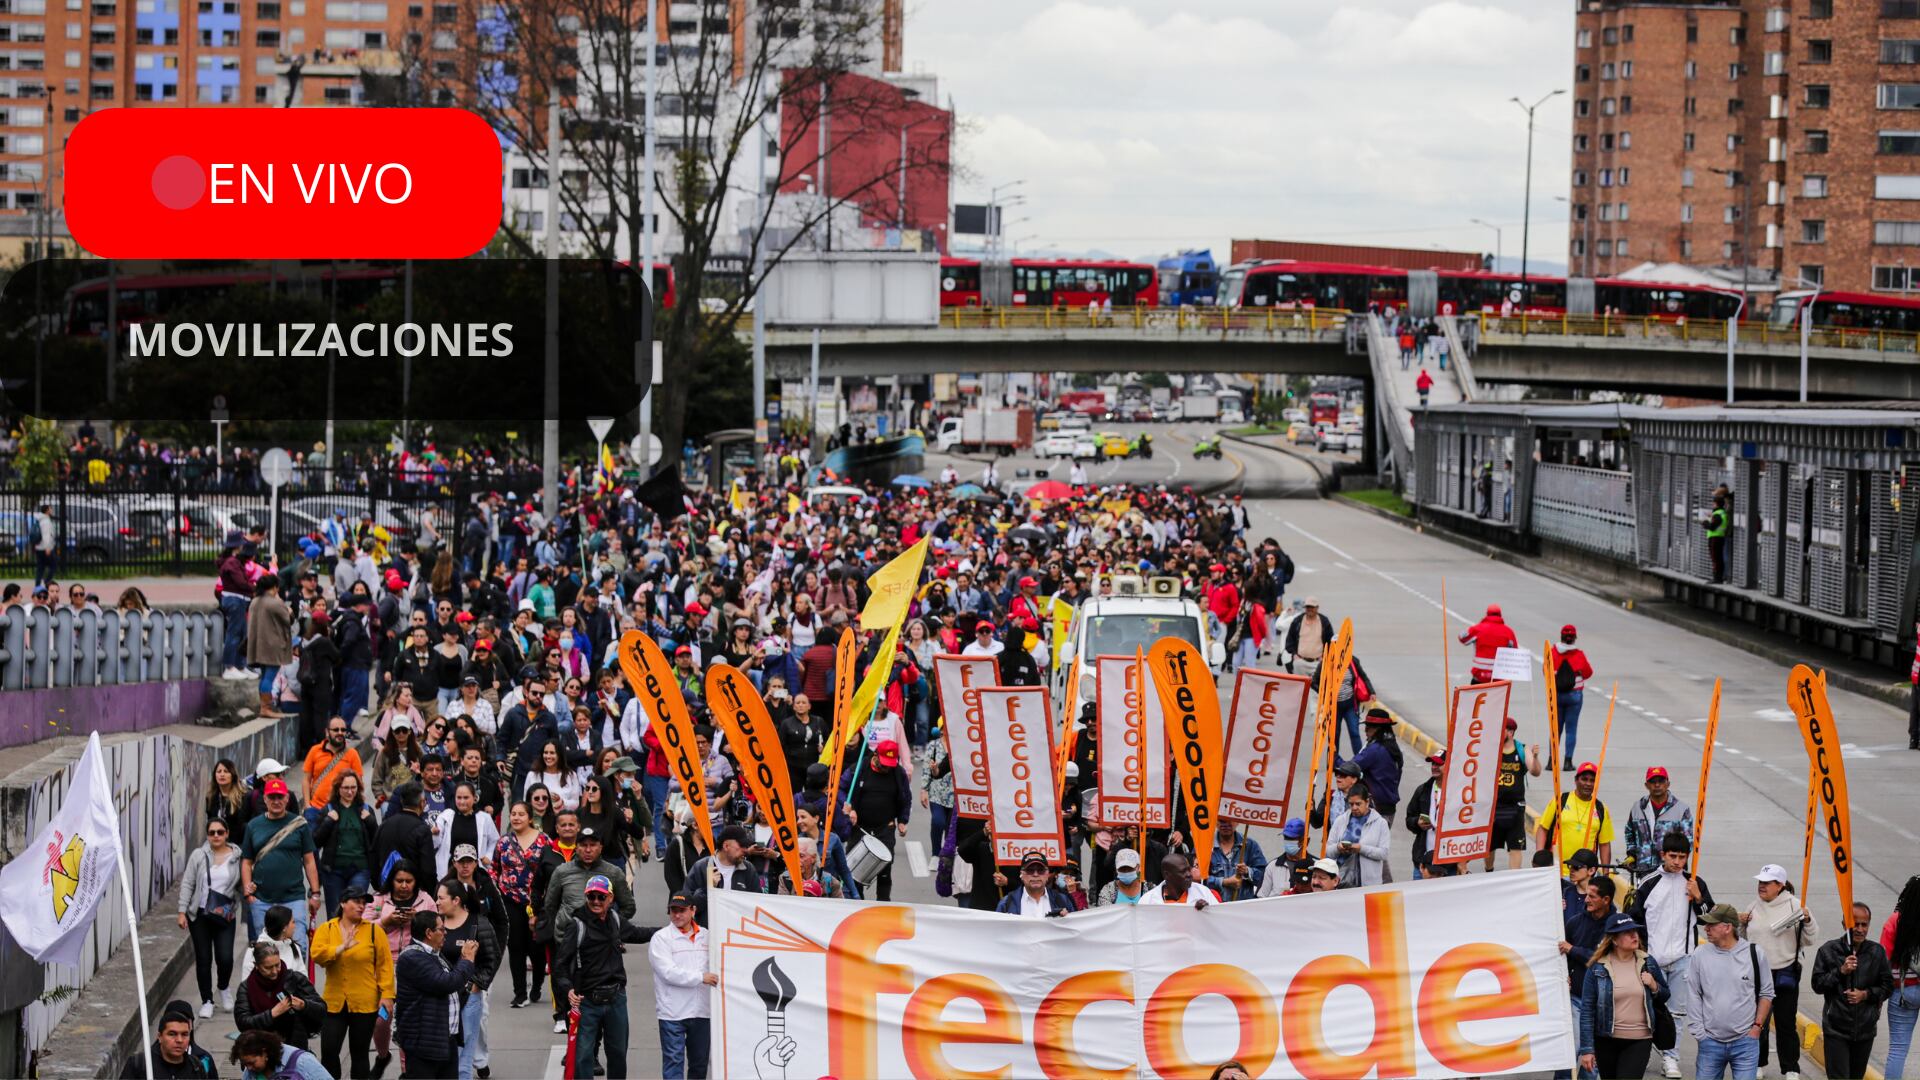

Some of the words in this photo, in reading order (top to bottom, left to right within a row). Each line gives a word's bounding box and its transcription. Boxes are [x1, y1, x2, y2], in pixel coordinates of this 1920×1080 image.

[635, 640, 702, 806] fecode
[725, 674, 794, 852] fecode
[1007, 695, 1034, 828] fecode
[1176, 651, 1209, 830] fecode
[1245, 681, 1280, 794] fecode
[1458, 692, 1487, 824] fecode
[1803, 678, 1848, 874] fecode
[967, 797, 991, 813] fec
[1228, 801, 1278, 821] fecode
[1446, 836, 1485, 855] fecode
[826, 891, 1540, 1080] fecode
